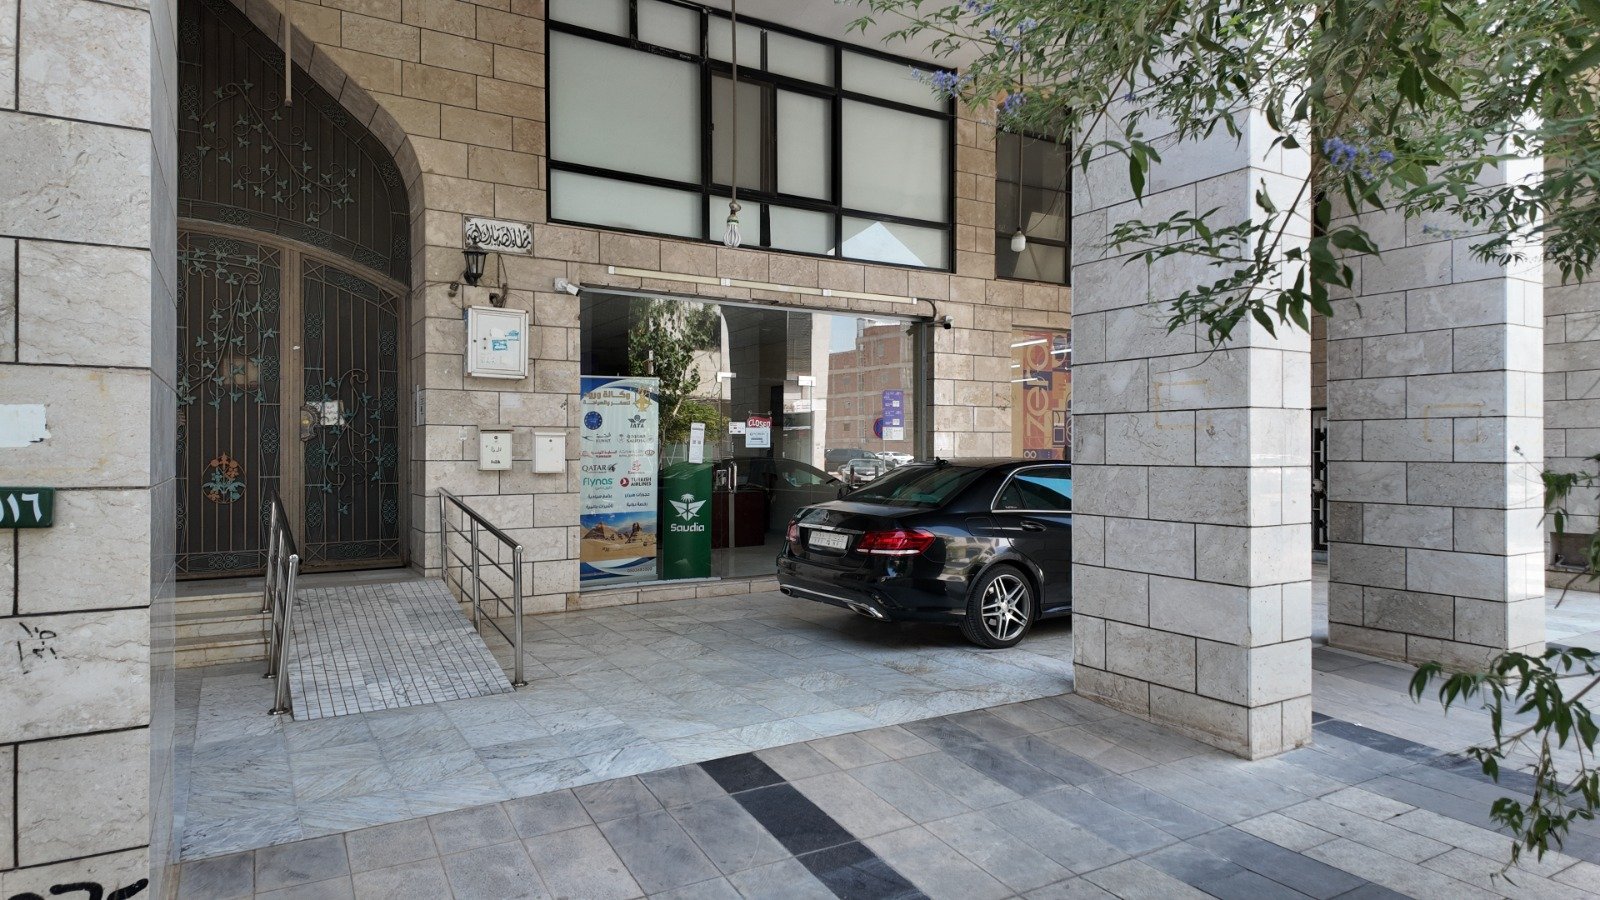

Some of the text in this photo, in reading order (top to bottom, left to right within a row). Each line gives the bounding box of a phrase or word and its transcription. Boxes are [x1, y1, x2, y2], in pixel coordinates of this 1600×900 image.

[582, 464, 607, 472] QATAR
[582, 477, 613, 487] flynas
[670, 522, 705, 532] Saudia
